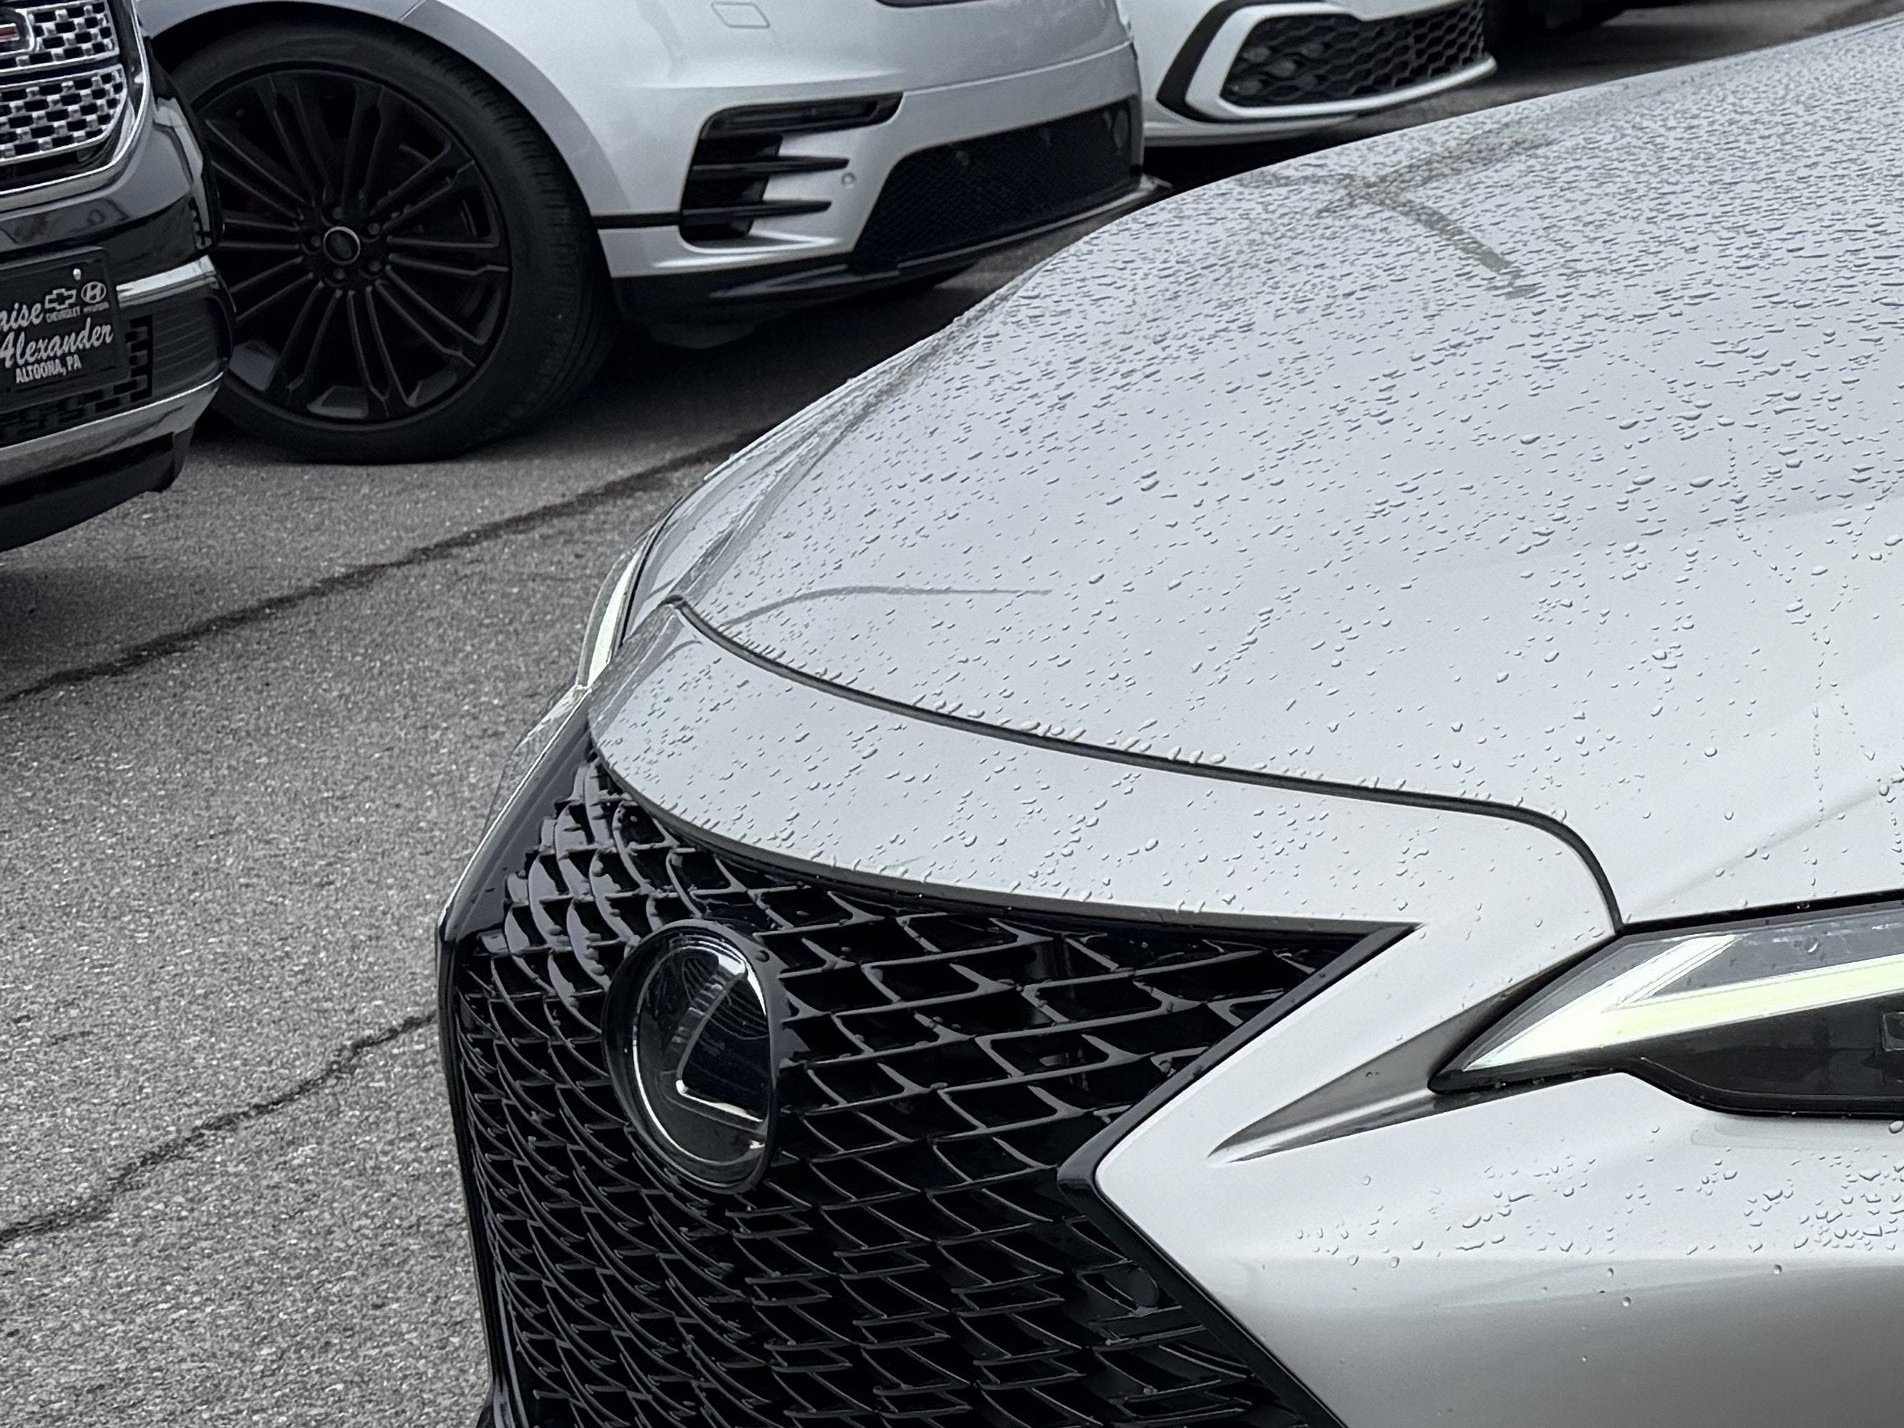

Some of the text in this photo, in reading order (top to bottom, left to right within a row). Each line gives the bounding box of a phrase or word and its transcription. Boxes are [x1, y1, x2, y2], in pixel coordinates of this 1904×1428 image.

[0, 317, 113, 368] Alexander
[16, 354, 82, 384] ALTOONA, PA
